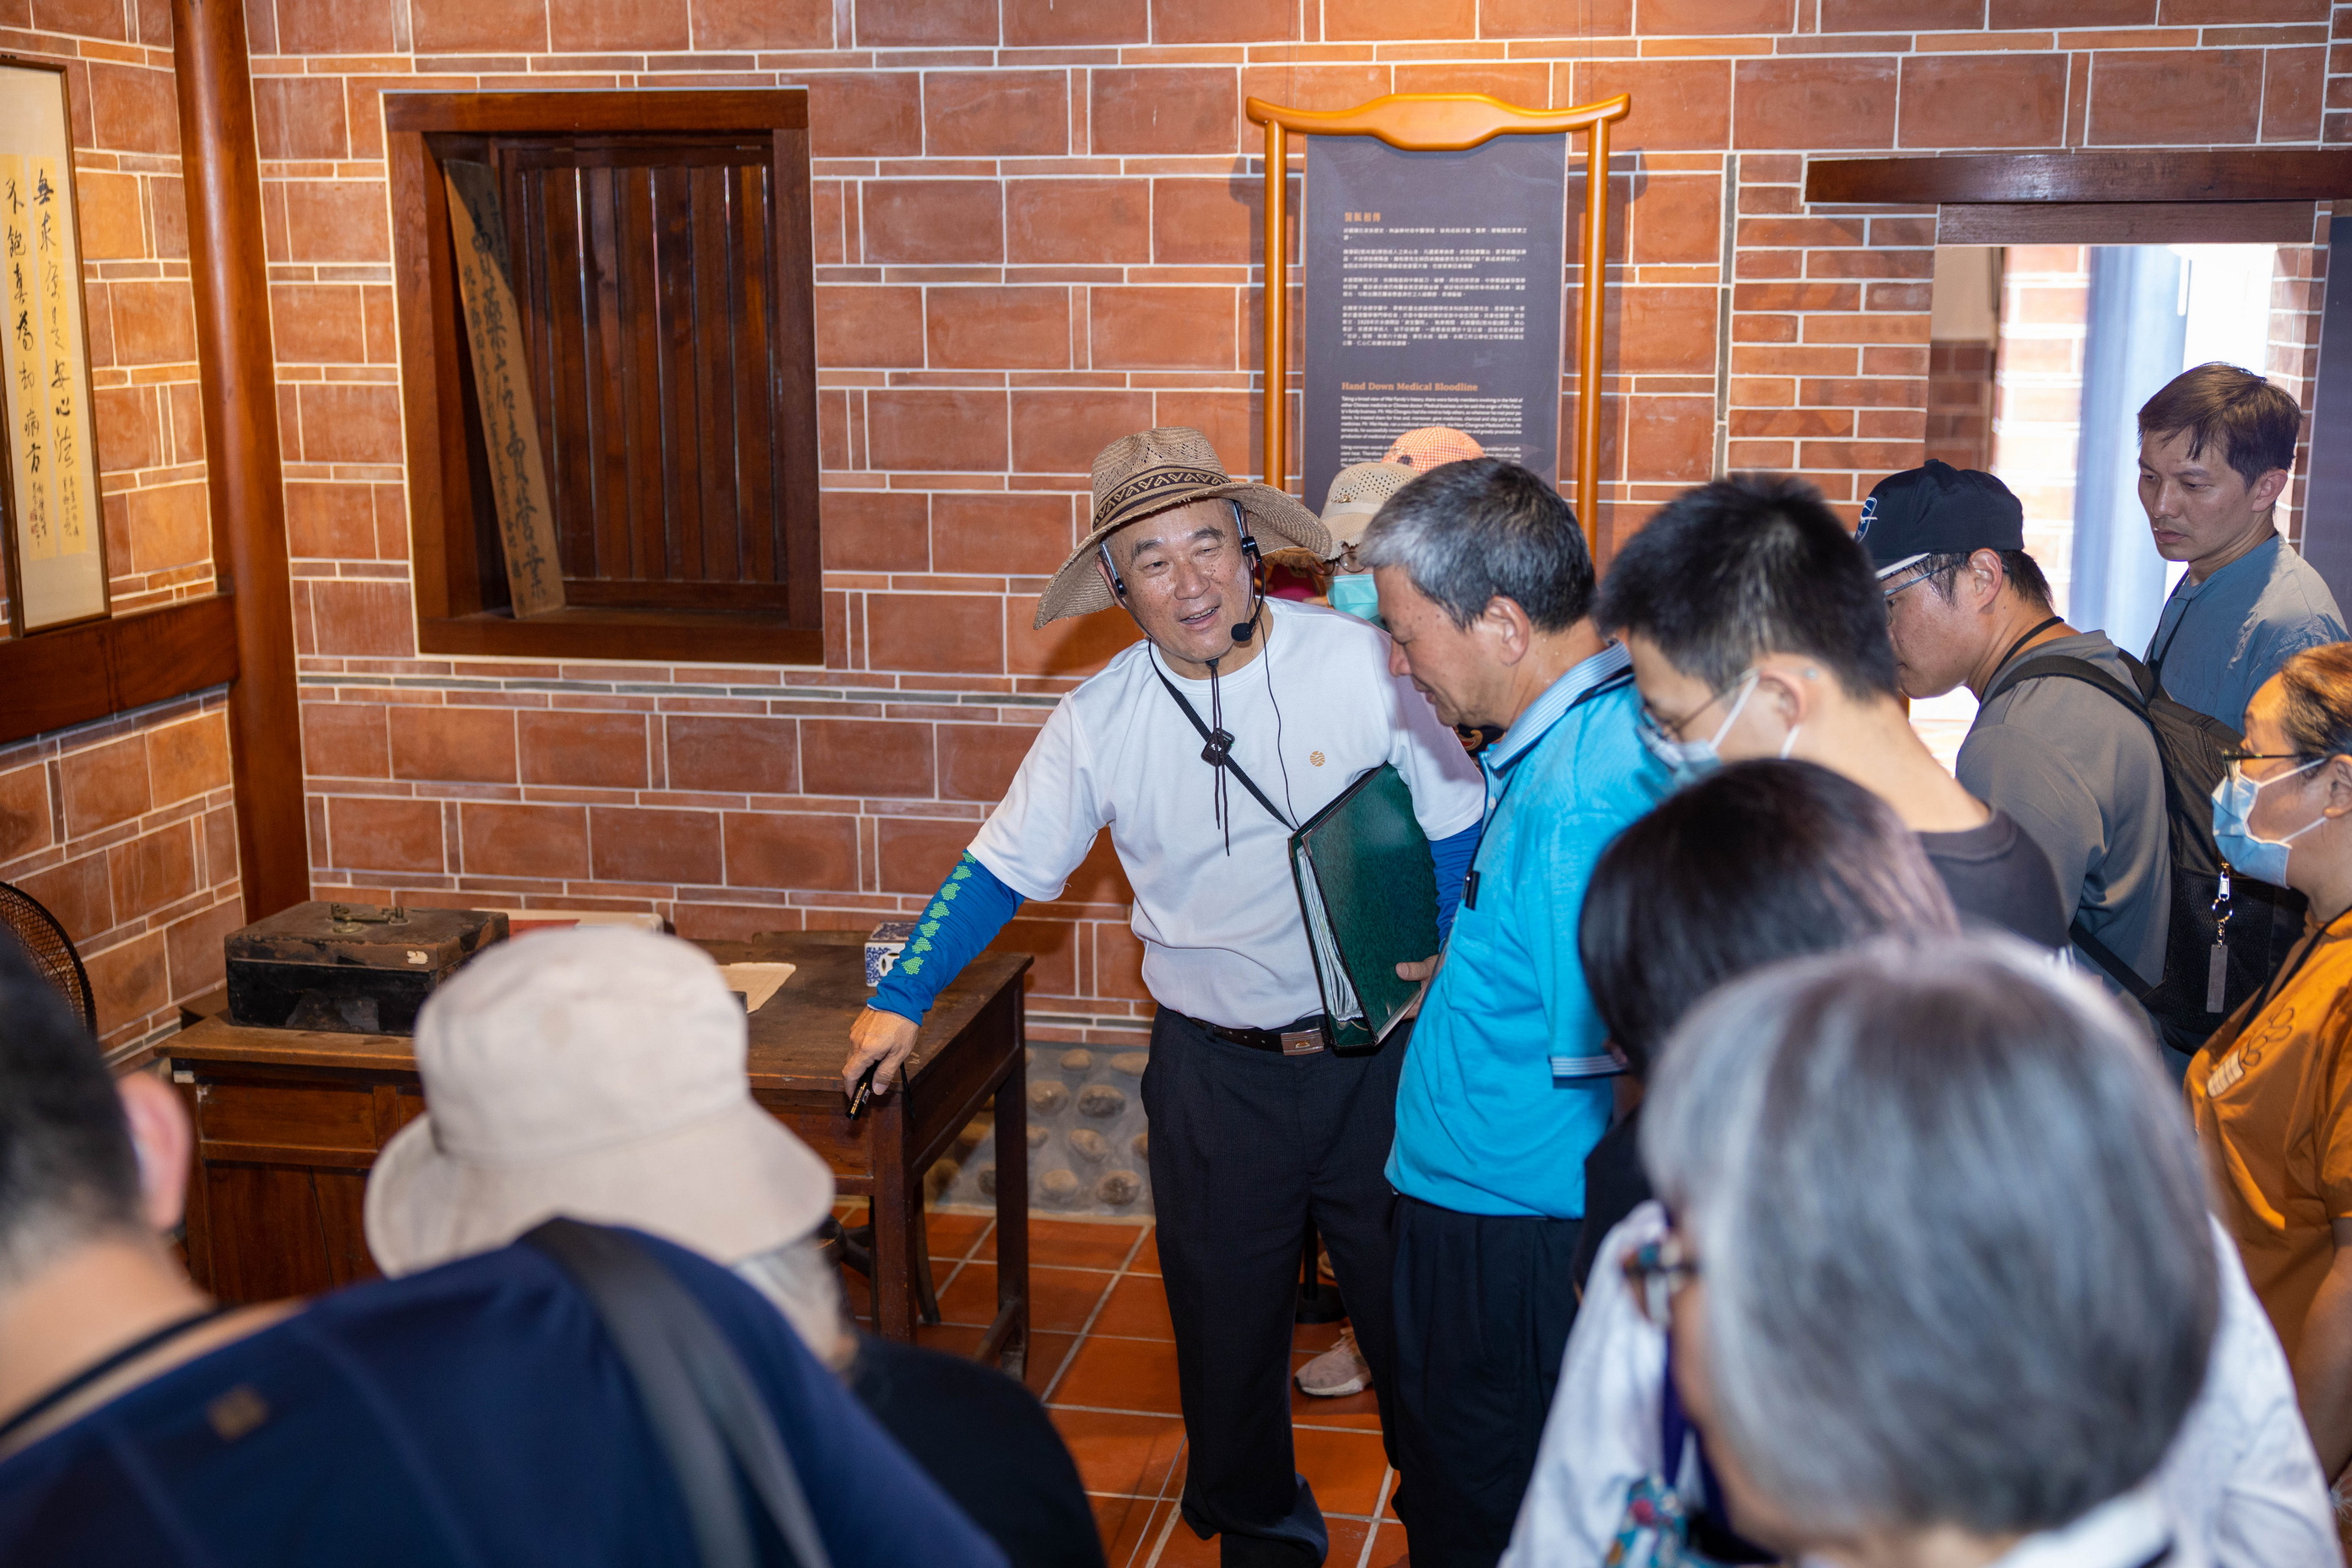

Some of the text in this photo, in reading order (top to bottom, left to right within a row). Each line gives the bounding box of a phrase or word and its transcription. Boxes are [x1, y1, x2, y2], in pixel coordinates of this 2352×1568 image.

[1341, 382, 1478, 391] Hand Down Medical Bloodline
